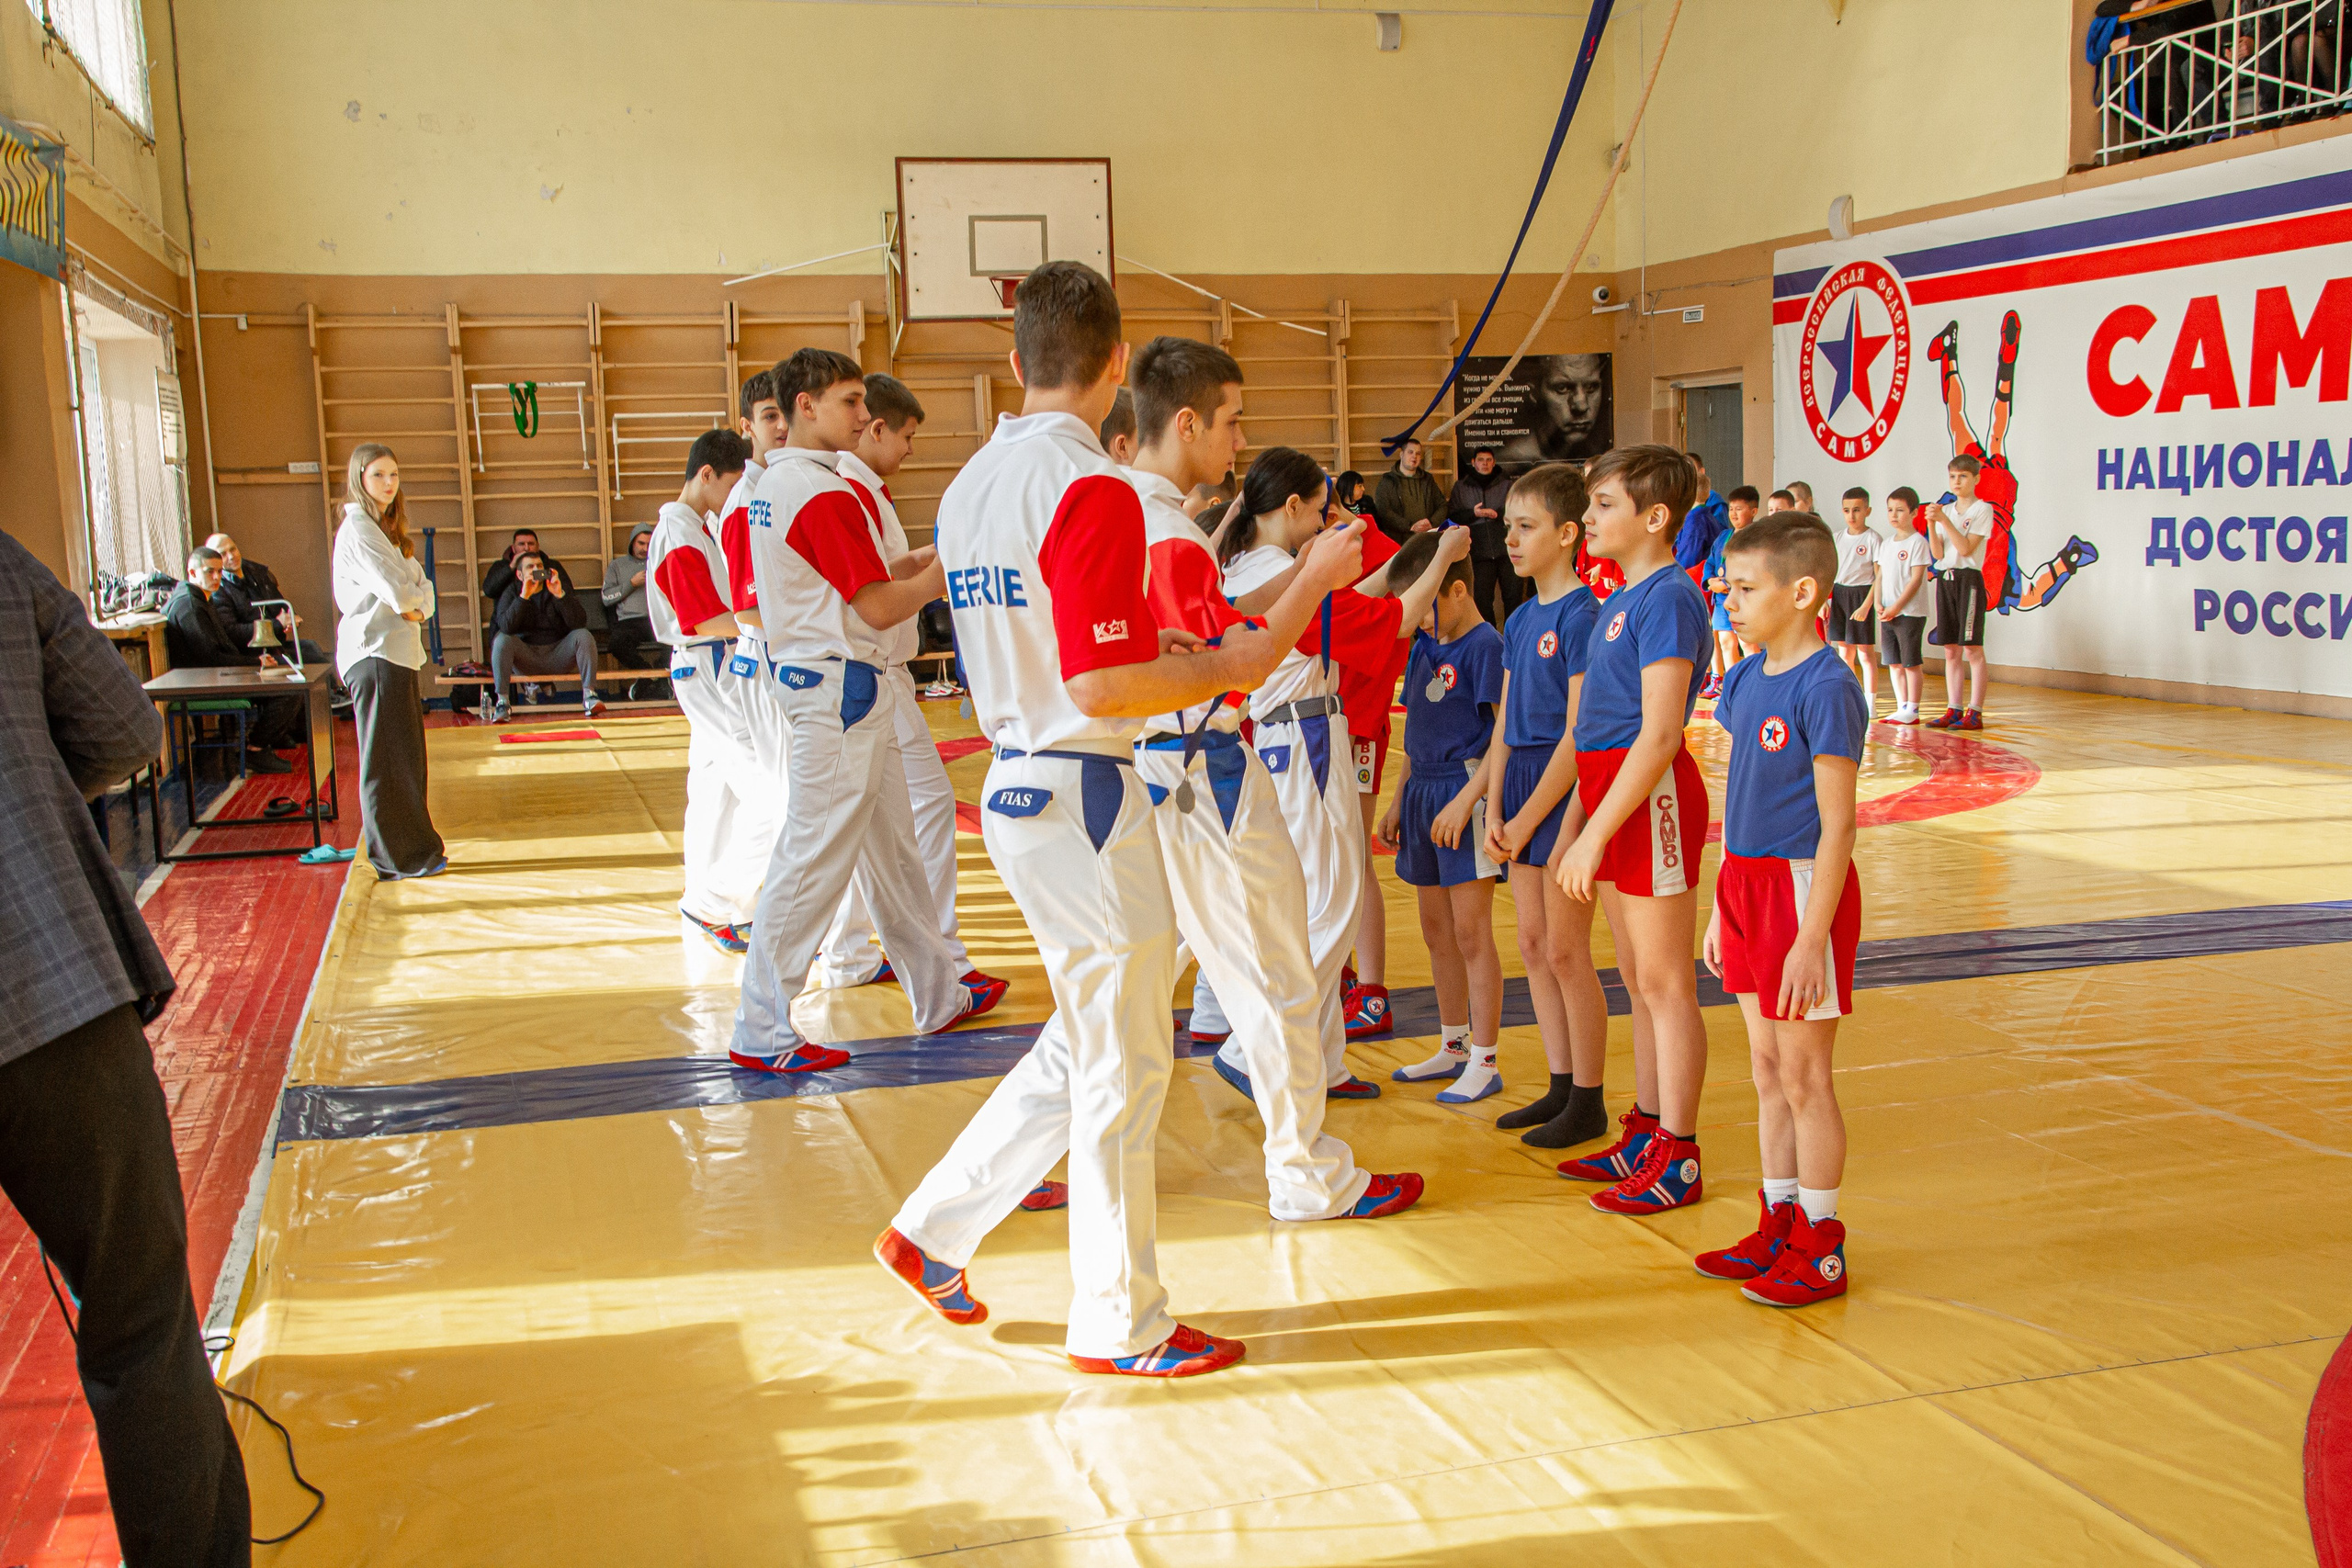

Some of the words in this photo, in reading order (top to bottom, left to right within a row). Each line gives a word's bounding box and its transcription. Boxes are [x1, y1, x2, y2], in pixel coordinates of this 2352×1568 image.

[1803, 267, 1865, 408] ВСЕРОССИЙСКАЯ
[1877, 277, 1907, 402] ФЕДЕРАЦИЯ
[1815, 418, 1888, 458] САМБО
[2145, 515, 2348, 567] ДОСТОЯ
[788, 671, 806, 686] FIAS
[999, 791, 1033, 807] FIAS
[1657, 794, 1679, 869] САМБО
